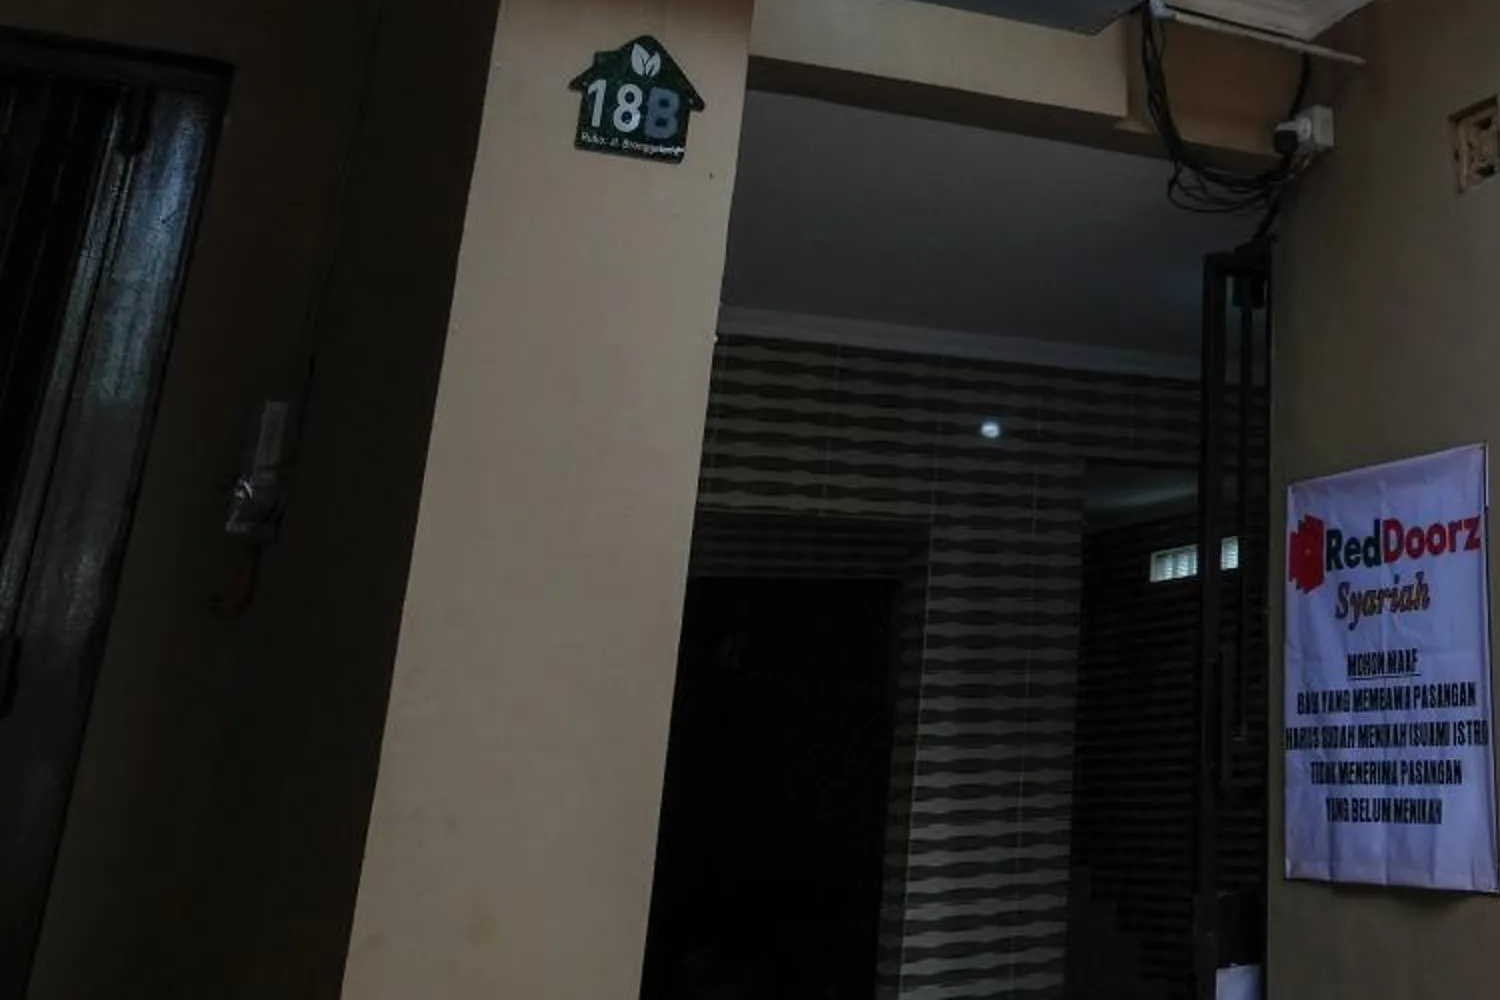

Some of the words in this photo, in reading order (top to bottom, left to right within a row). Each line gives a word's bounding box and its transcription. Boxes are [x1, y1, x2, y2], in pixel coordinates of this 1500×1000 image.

[587, 79, 681, 139] 18B
[1326, 514, 1481, 572] RedDoorz
[1335, 571, 1431, 631] Syariah
[1321, 688, 1351, 713] YANG
[1413, 682, 1477, 709] PASANGAN
[1401, 759, 1463, 785] PASANGAN
[1351, 797, 1392, 823] BELUM
